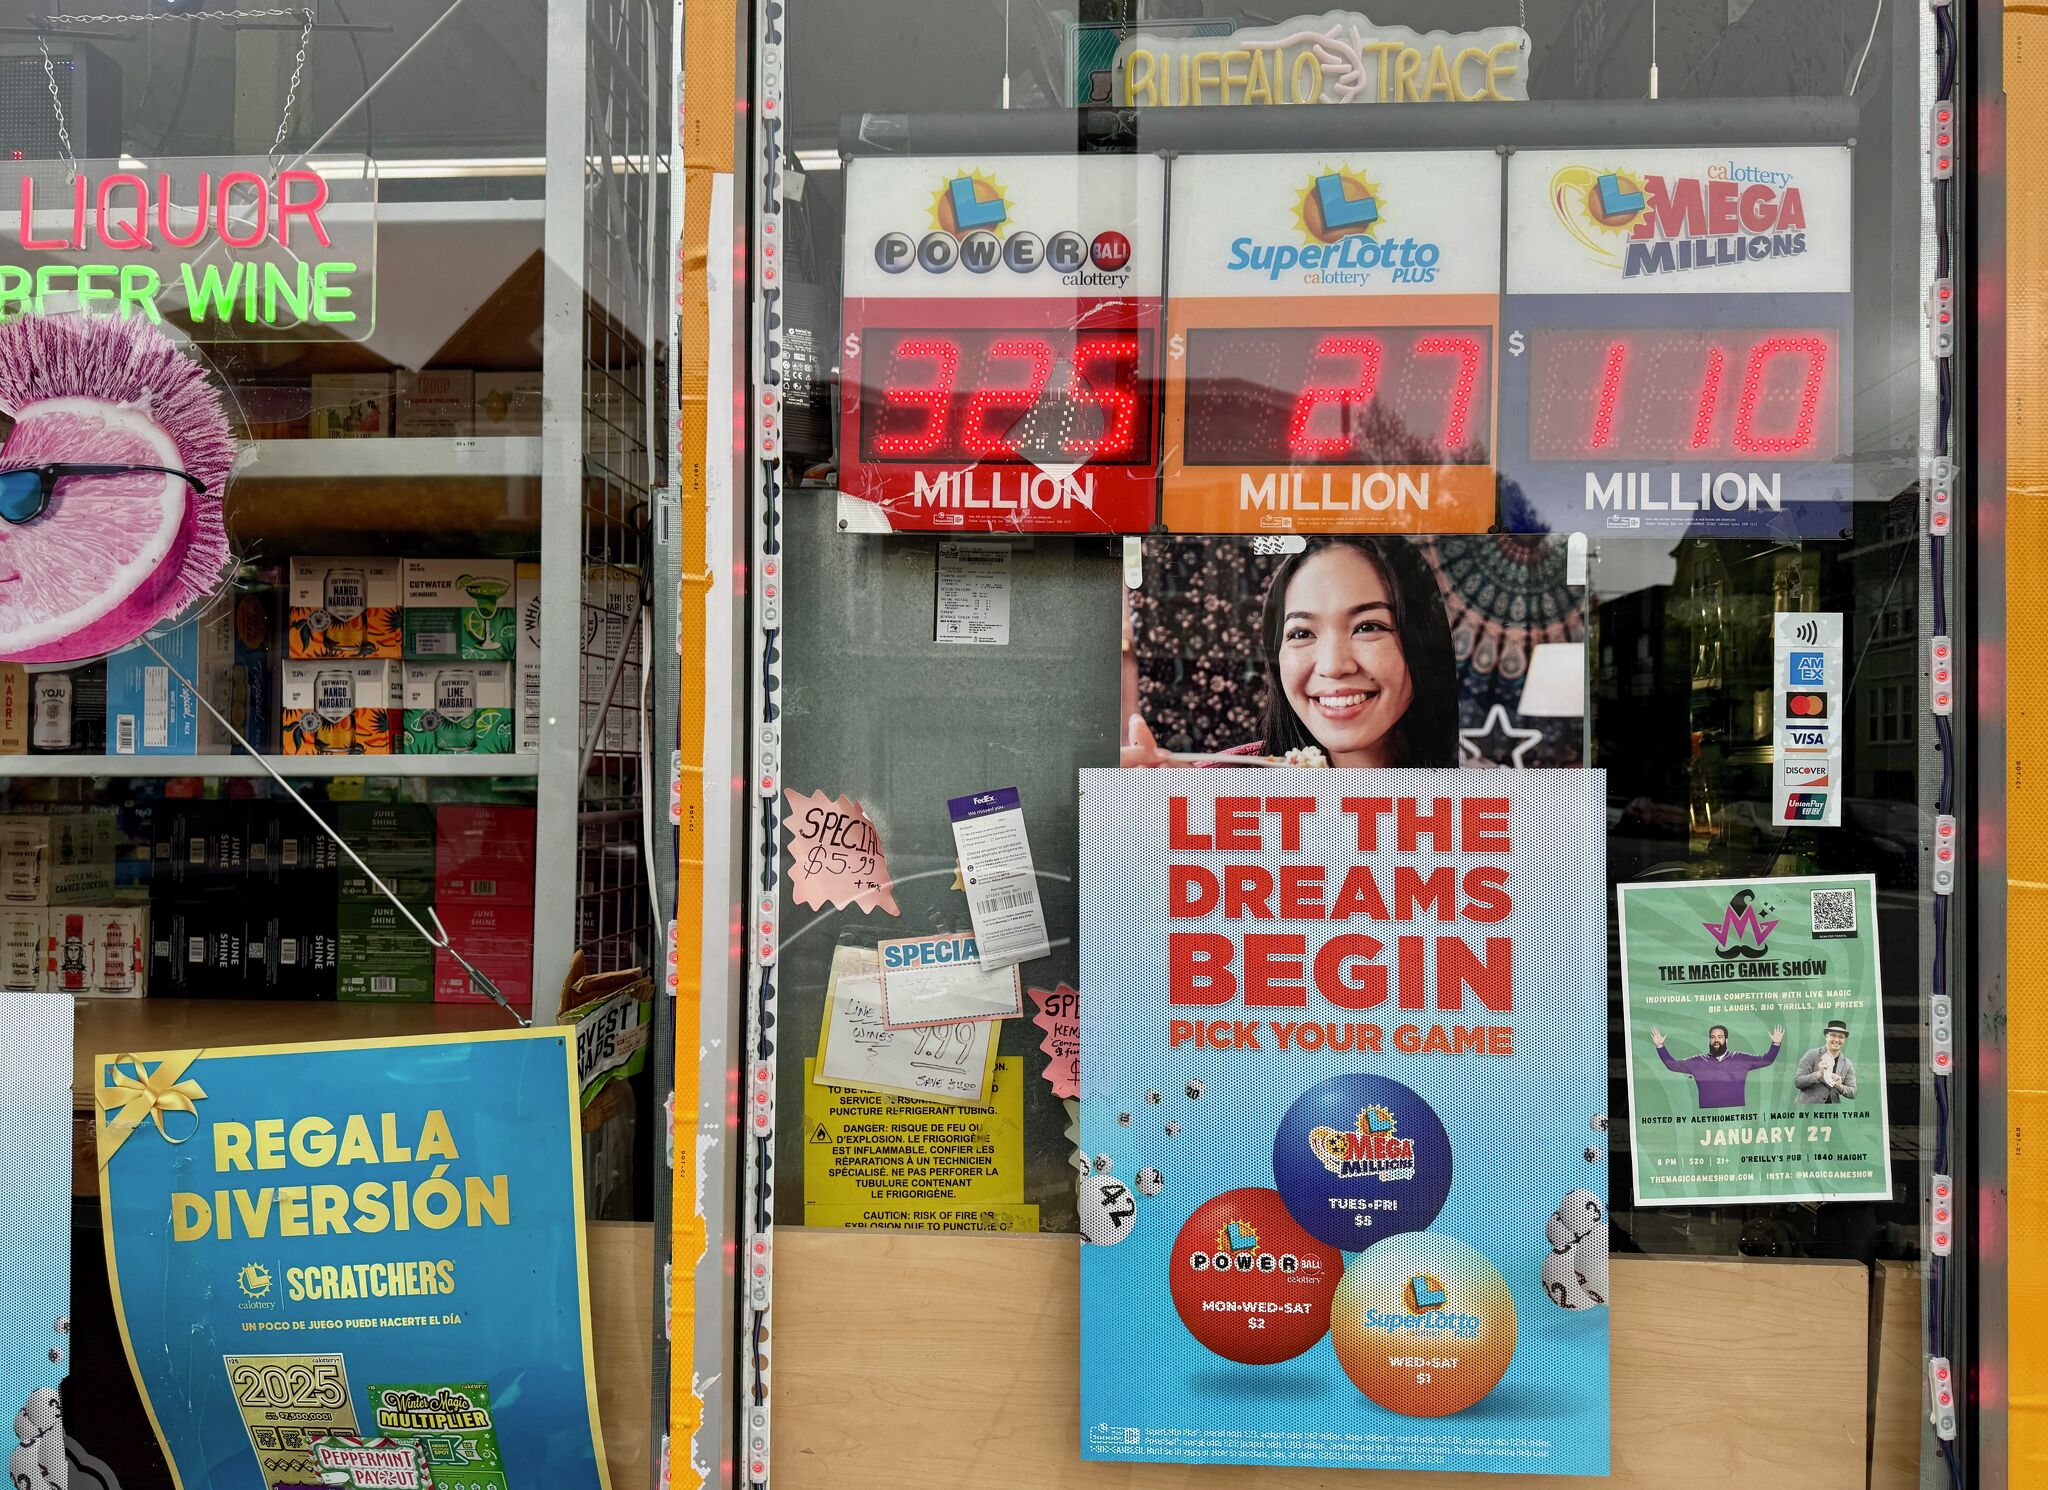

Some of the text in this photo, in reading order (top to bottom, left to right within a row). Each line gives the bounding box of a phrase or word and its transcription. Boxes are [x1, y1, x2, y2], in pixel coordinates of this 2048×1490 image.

[1123, 42, 1517, 105] BUFFALO TRACE
[1708, 161, 1793, 188] calottery
[19, 170, 332, 251] LIQUOR
[1629, 175, 1807, 240] MEGA
[1226, 234, 1439, 281] SuperLotto
[1622, 233, 1807, 279] MILLIONS
[1062, 271, 1129, 288] calottery
[1303, 271, 1371, 287] calottery
[1391, 267, 1436, 283] PLUS
[0, 261, 357, 324] BEER WINE
[845, 333, 860, 358] $
[877, 340, 1139, 453] 325
[1169, 334, 1479, 453] $ 27
[1508, 331, 1828, 452] $ 110
[913, 470, 1094, 510] MILLION
[1239, 472, 1430, 511] MILLION
[1585, 471, 1782, 511] MILLION
[333, 586, 358, 596] MANGO
[409, 580, 452, 589] CUTWATER
[328, 596, 364, 607] MARGARITA
[1799, 658, 1823, 669] AM
[1802, 669, 1823, 680] EX
[41, 689, 66, 698] YOJU
[323, 687, 347, 697] MANGO
[447, 687, 464, 697] LIME
[4, 674, 15, 730] MADRE
[318, 698, 352, 709] MARGARITA
[438, 698, 473, 709] MARGARITA
[1791, 732, 1824, 745] VISA
[1786, 766, 1826, 775] DISCOVER
[973, 795, 995, 805] FedEx
[1788, 799, 1825, 809] UnionPay
[374, 809, 396, 819] JUNE
[372, 818, 398, 827] SHINE
[1169, 796, 1511, 853] LET THE
[800, 808, 885, 858] SPECIAL
[220, 833, 229, 868] SHINE
[803, 844, 875, 880] $5.99
[55, 882, 80, 893] CANNED
[1169, 864, 1513, 923] DREAMS
[371, 916, 397, 925] SHINE
[373, 908, 395, 917] JUNE
[219, 933, 228, 968] SHINE
[231, 935, 240, 966] JUNE
[314, 935, 324, 970] SHINE
[326, 938, 335, 968] JUNE
[1169, 933, 1513, 1012] BEGIN
[1658, 960, 1827, 981] THE MAGIC GAME SHOW
[1646, 995, 1691, 1003] INDIVIDUAL
[1724, 992, 1778, 1000] COMPETITION
[1724, 1004, 1757, 1012] LAUGHS,
[853, 1027, 894, 1042] WINES
[1169, 1019, 1514, 1056] PICK YOUR GAME
[840, 1096, 881, 1105] SERVICE
[830, 1107, 998, 1115] PUNCTURE REFRIGERANT TUBING.
[1691, 1114, 1758, 1123] ALETHIOMETRIST
[844, 1124, 888, 1132] DANGER:
[891, 1124, 928, 1132] RISQUE
[931, 1124, 944, 1132] DE
[947, 1124, 965, 1132] FEU
[1700, 1126, 1831, 1146] JANUARY 27
[213, 1109, 460, 1173] REGALA
[837, 1135, 904, 1143] D'EXPLOSION.
[908, 1135, 920, 1143] LE
[1344, 1132, 1412, 1160] MEGA
[833, 1147, 851, 1155] EST
[854, 1146, 927, 1154] INFLAMMABLE.
[930, 1146, 973, 1154] CONFIER
[1741, 1155, 1783, 1163] O'REILLY'S
[1787, 1154, 1801, 1162] PUB
[835, 1155, 991, 1166] RÉPARATIONS À UN TECHNICIEN
[1341, 1159, 1414, 1176] MILLIONS
[829, 1167, 888, 1177] SPÉCIALISÉ.
[892, 1168, 904, 1176] NE
[908, 1168, 926, 1176] PAS
[930, 1168, 983, 1176] PERFORER
[1650, 1171, 1873, 1183] THEMAGICGAMESHOW.COM INSTA: @MAGICGAMESHOW
[856, 1179, 972, 1187] TUBULURE CONTENANT
[871, 1188, 956, 1198] LE FRIGORIGÈNE.
[171, 1164, 511, 1242] DIVERSIÓN
[864, 1211, 910, 1219] CAUTION:
[914, 1211, 936, 1219] RISK
[956, 1212, 977, 1220] FIRE
[288, 1259, 456, 1302] SCRATCHERS
[238, 1300, 276, 1311] calottery
[241, 1313, 461, 1331] UN POCO DE JUEGO PUEDE HACERTE EL DÍA
[1248, 1316, 1266, 1331] $2
[1364, 1308, 1481, 1334] SuperLotto
[1416, 1371, 1432, 1385] $1
[233, 1365, 347, 1409] 2025
[383, 1391, 470, 1413] Winter Magic
[381, 1410, 488, 1430] MULTIPLIER
[320, 1447, 412, 1469] PEPPERMINT
[355, 1469, 416, 1487] PAYOUT
